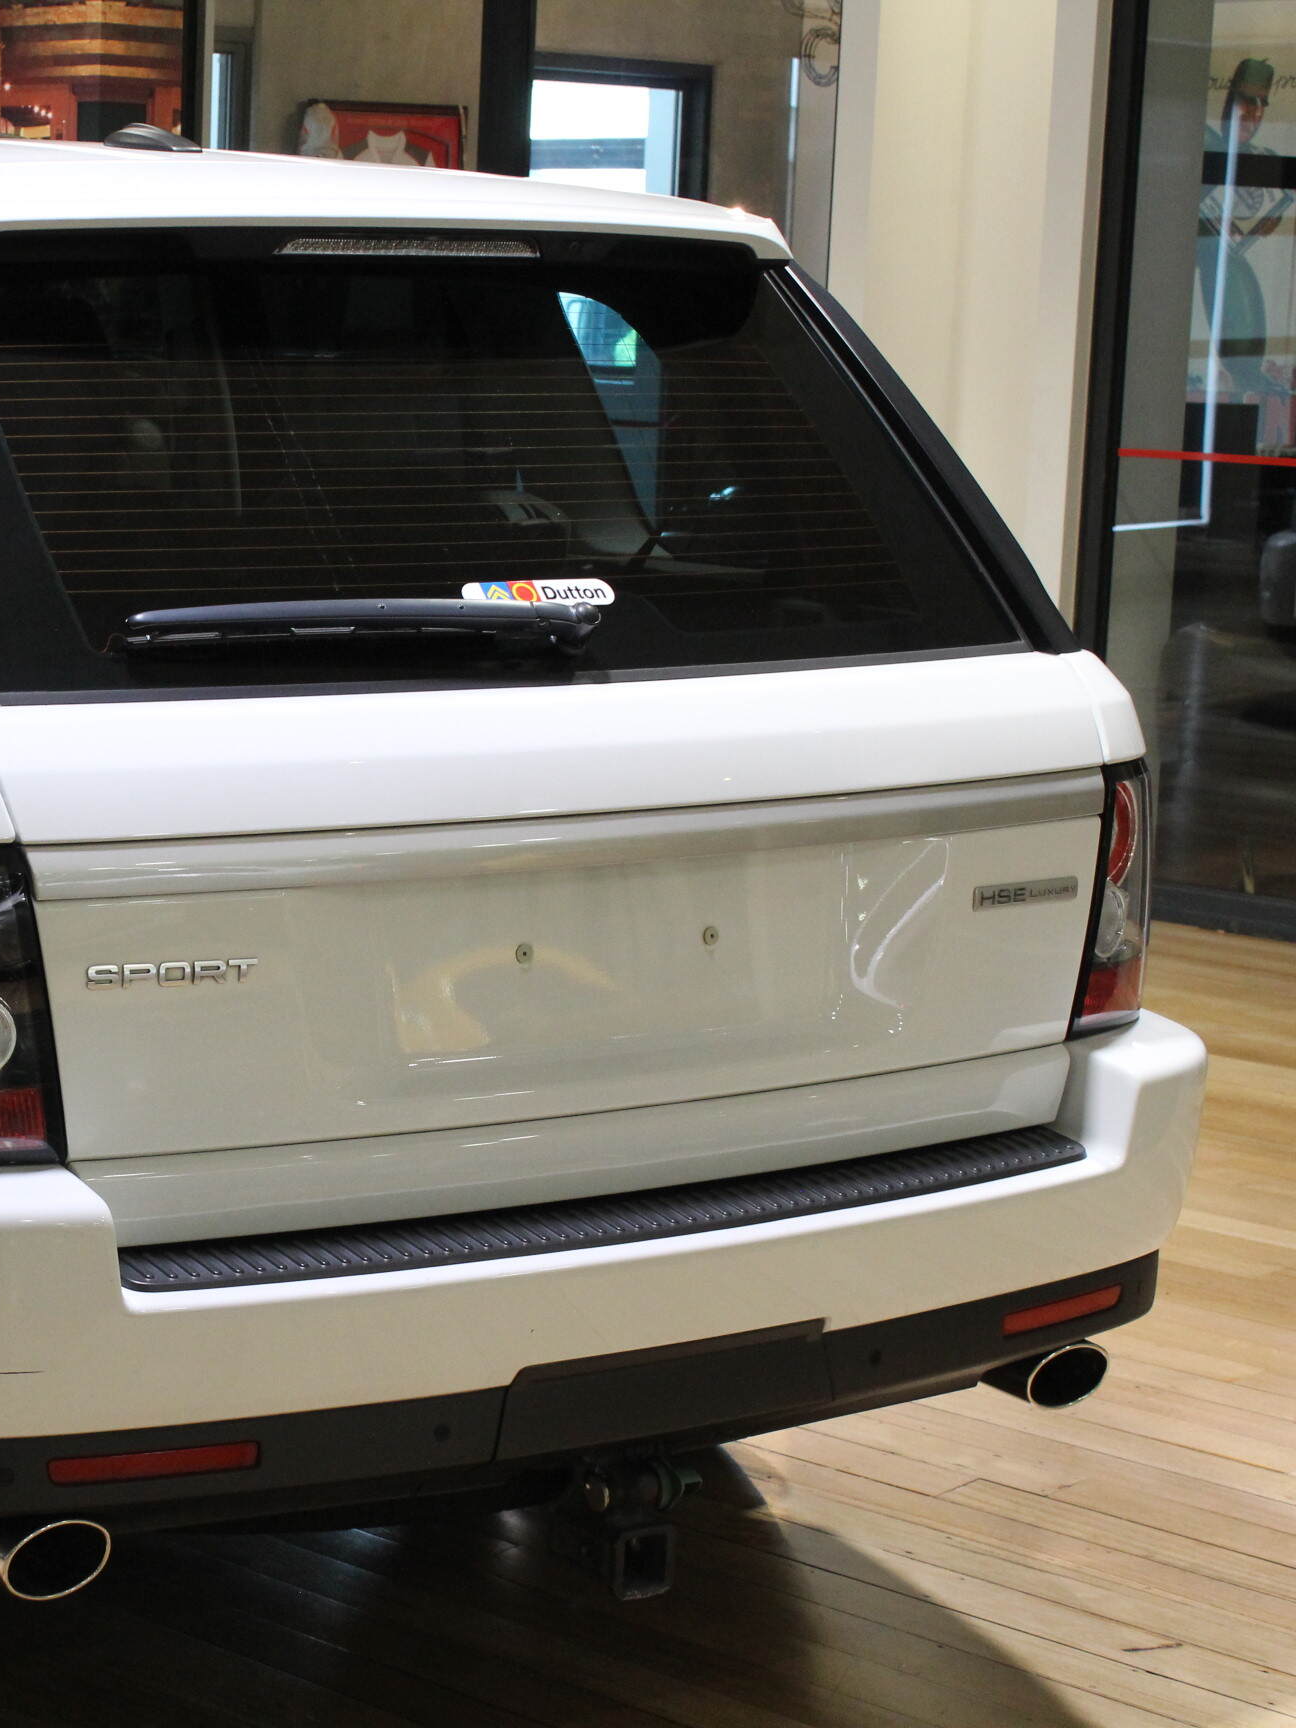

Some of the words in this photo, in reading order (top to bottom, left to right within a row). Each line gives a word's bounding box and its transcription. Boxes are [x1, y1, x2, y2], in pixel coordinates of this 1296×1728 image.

[541, 586, 607, 600] Dutton
[980, 887, 1026, 907] HSE
[86, 958, 259, 991] SPORT
